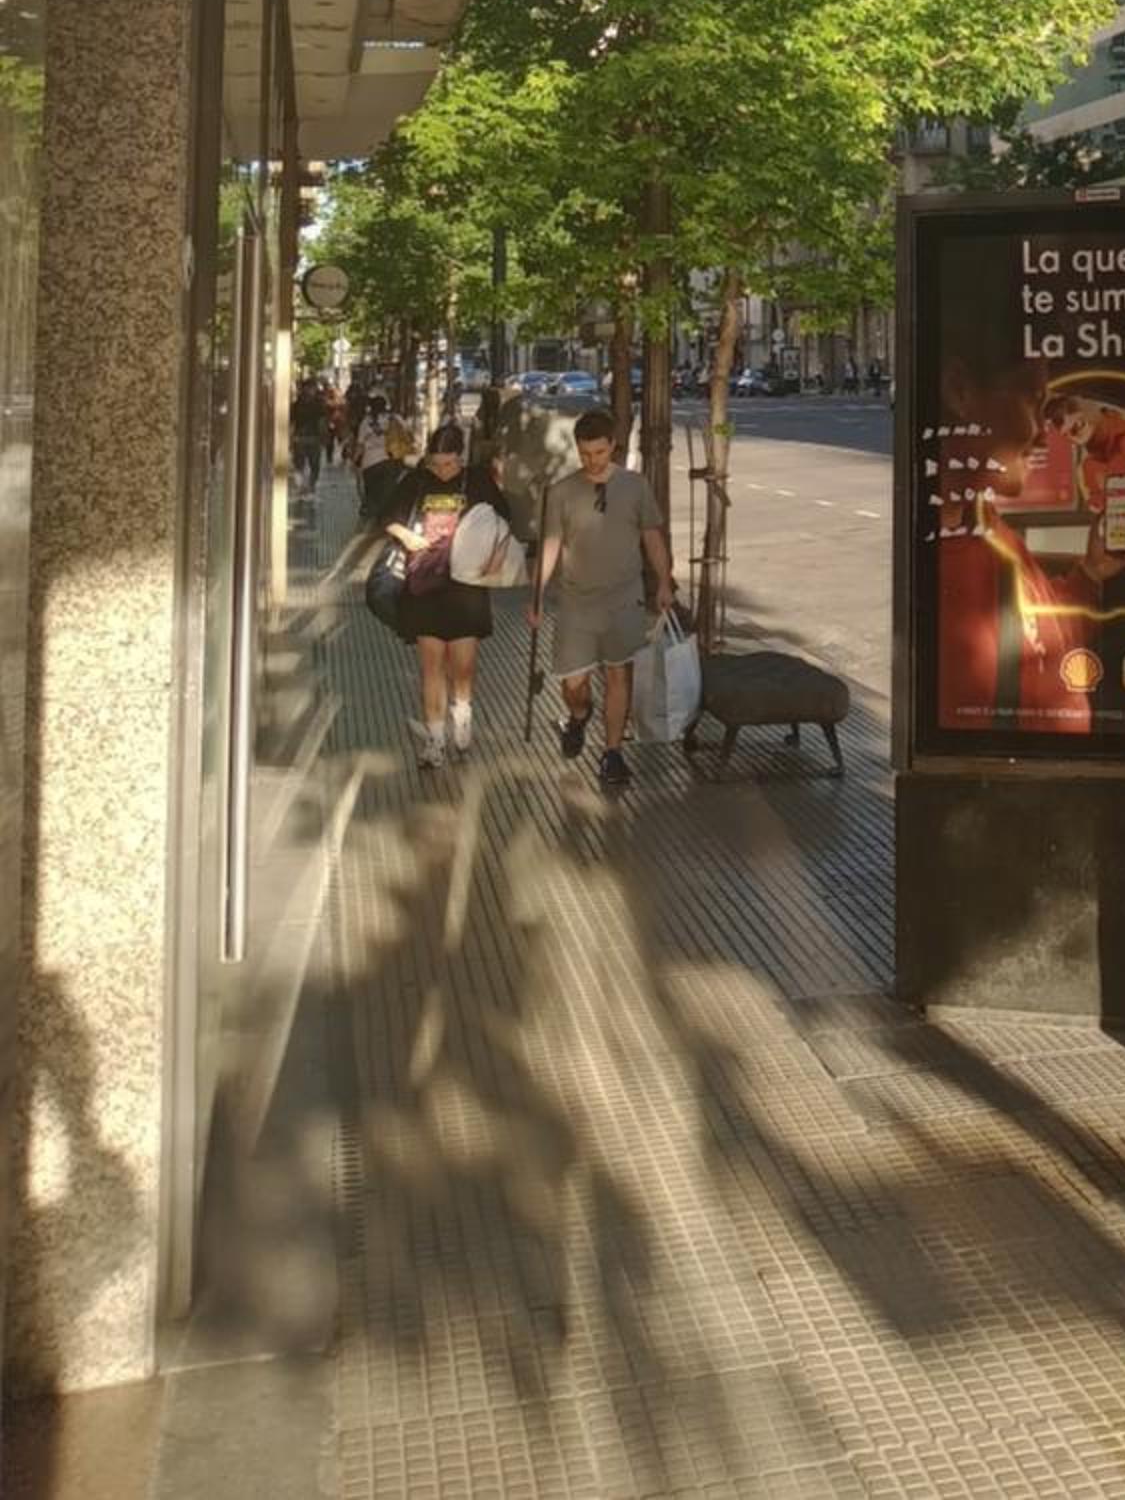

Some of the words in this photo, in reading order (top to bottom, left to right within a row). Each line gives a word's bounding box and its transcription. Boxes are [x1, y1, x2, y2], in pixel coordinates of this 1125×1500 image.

[1023, 240, 1060, 273] La
[1022, 284, 1054, 313] te
[1023, 323, 1065, 358] La
